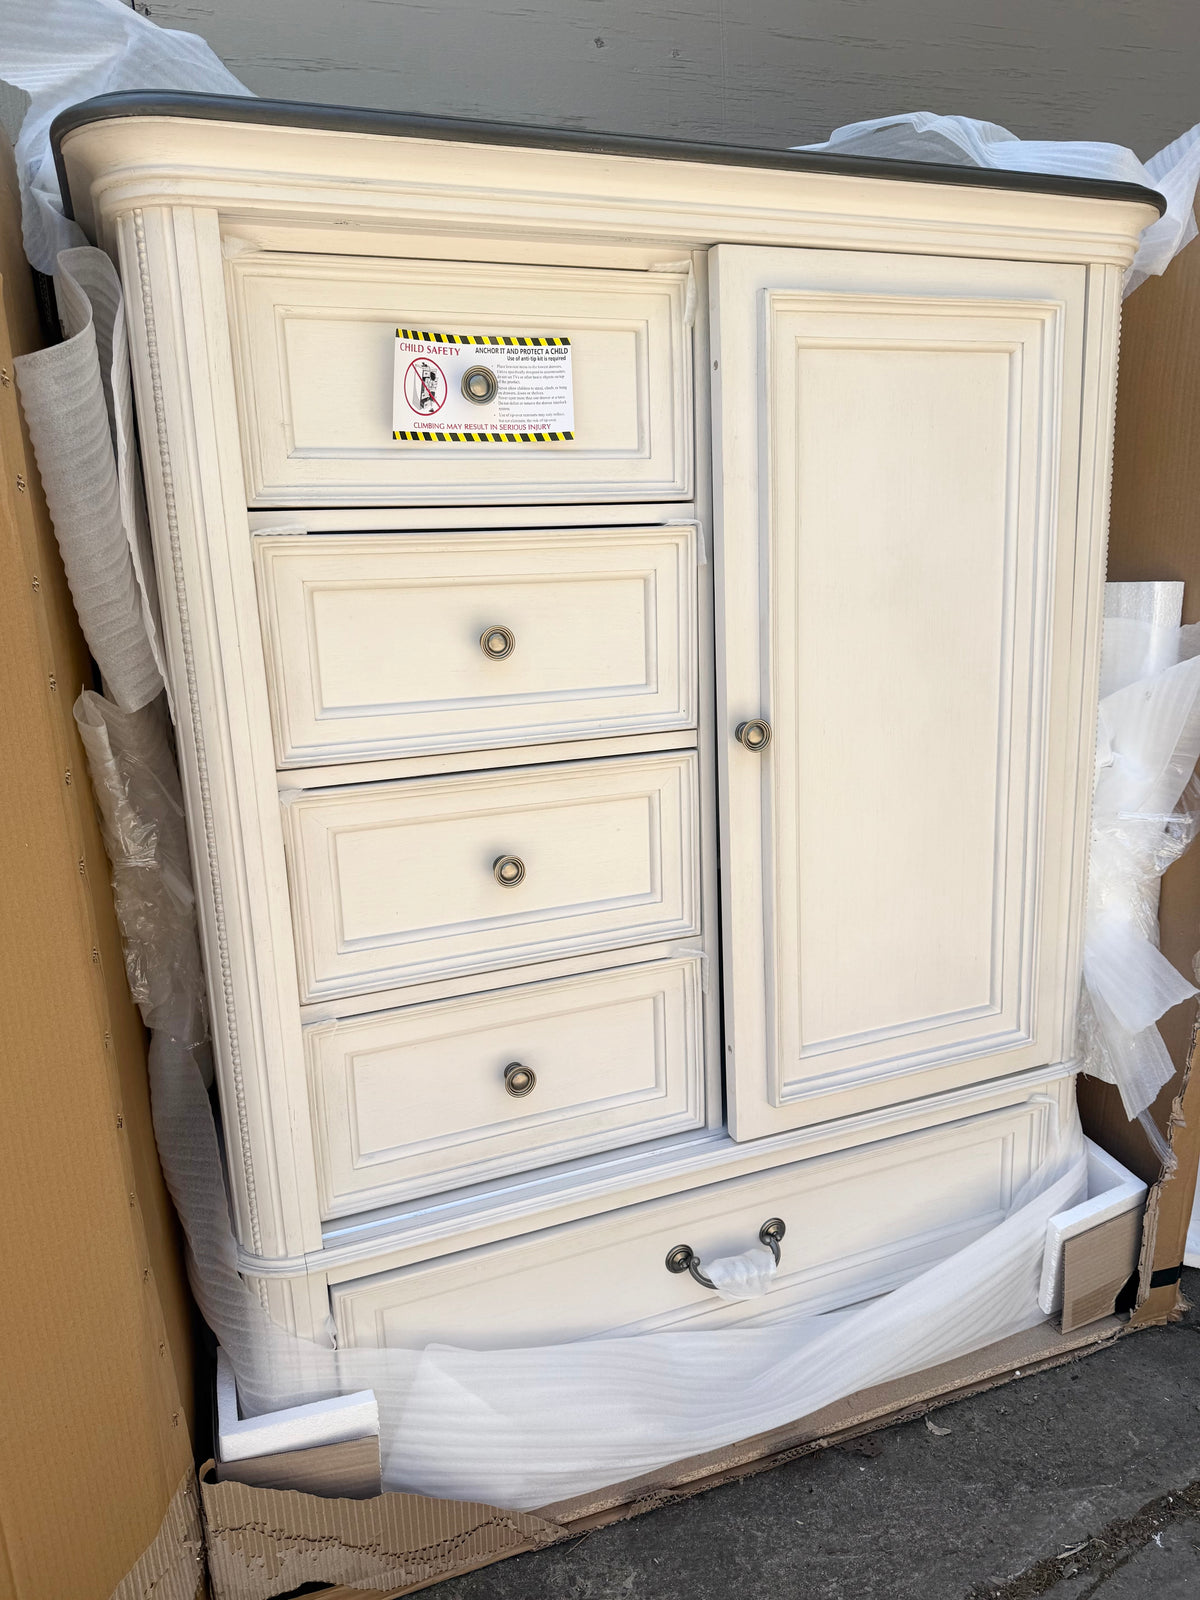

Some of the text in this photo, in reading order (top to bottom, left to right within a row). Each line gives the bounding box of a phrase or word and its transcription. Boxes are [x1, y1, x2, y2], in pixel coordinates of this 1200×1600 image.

[399, 342, 460, 356] CHILD SAFETY
[413, 422, 445, 430] CLIMBING
[528, 423, 551, 431] INJURY
